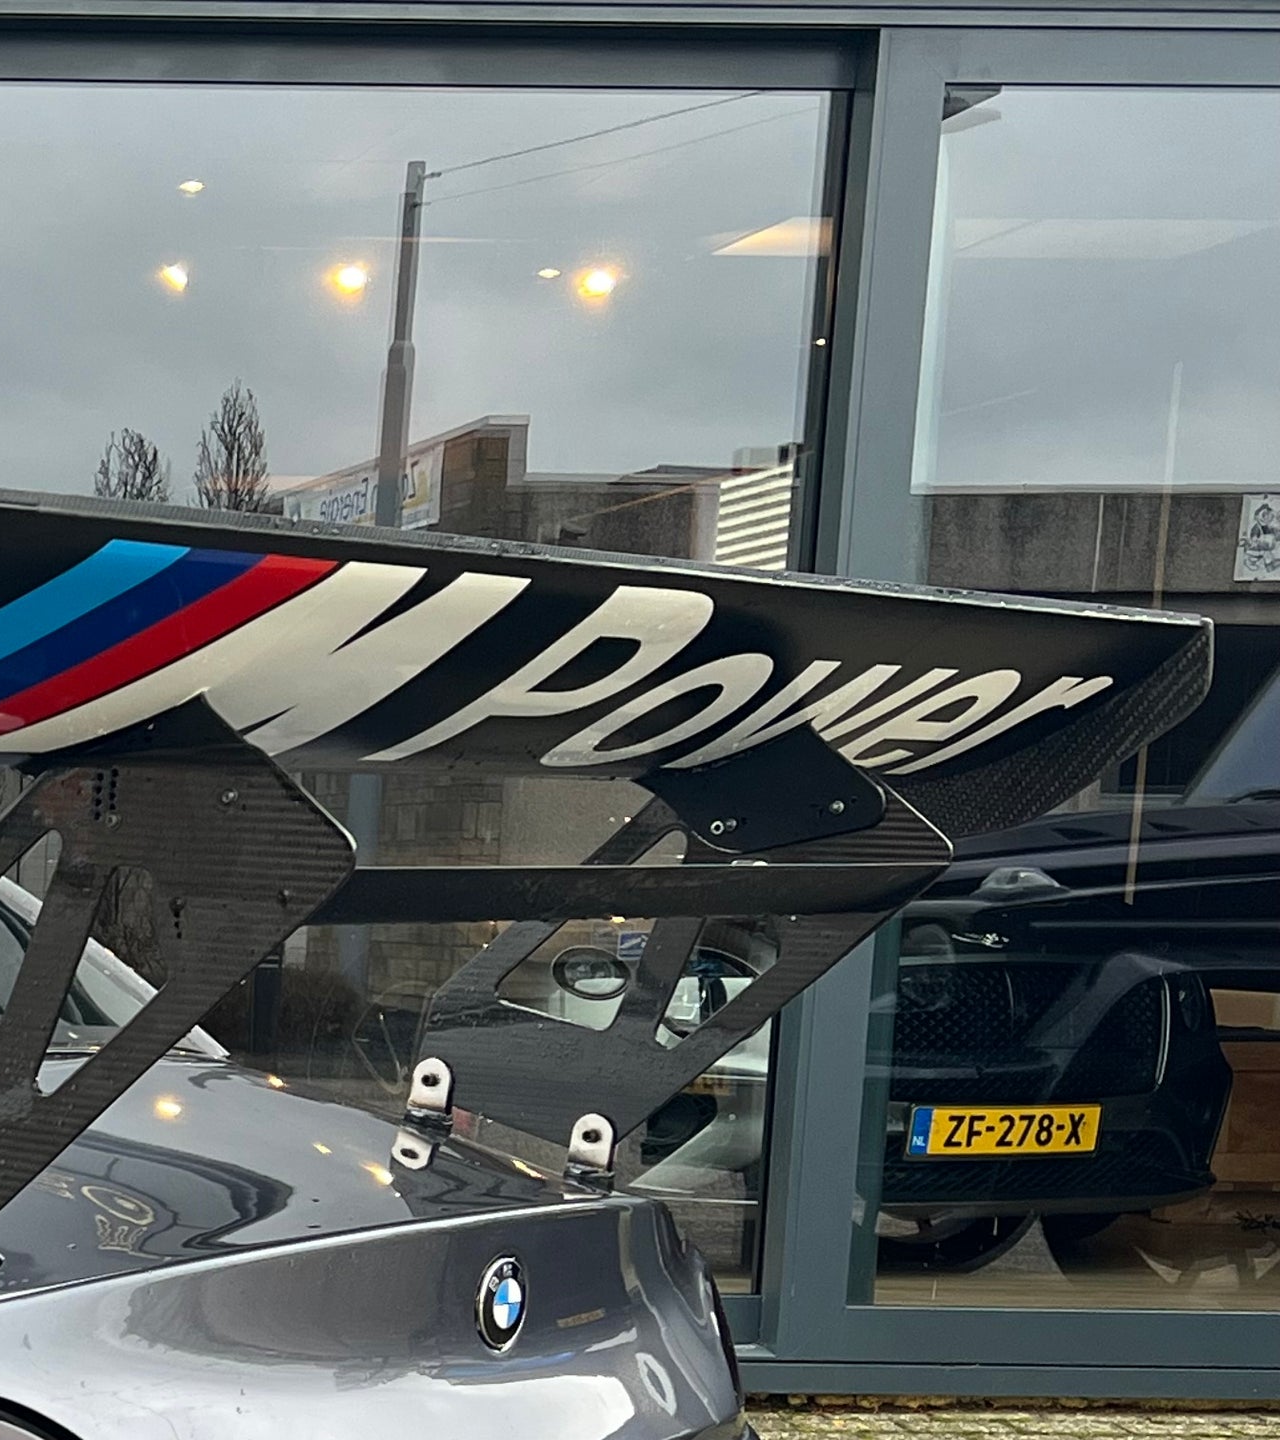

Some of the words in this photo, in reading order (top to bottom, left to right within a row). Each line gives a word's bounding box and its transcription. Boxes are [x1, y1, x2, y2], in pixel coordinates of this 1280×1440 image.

[359, 585, 1115, 776] Power
[912, 1135, 925, 1147] NL
[943, 1113, 1085, 1148] ZF-278-X
